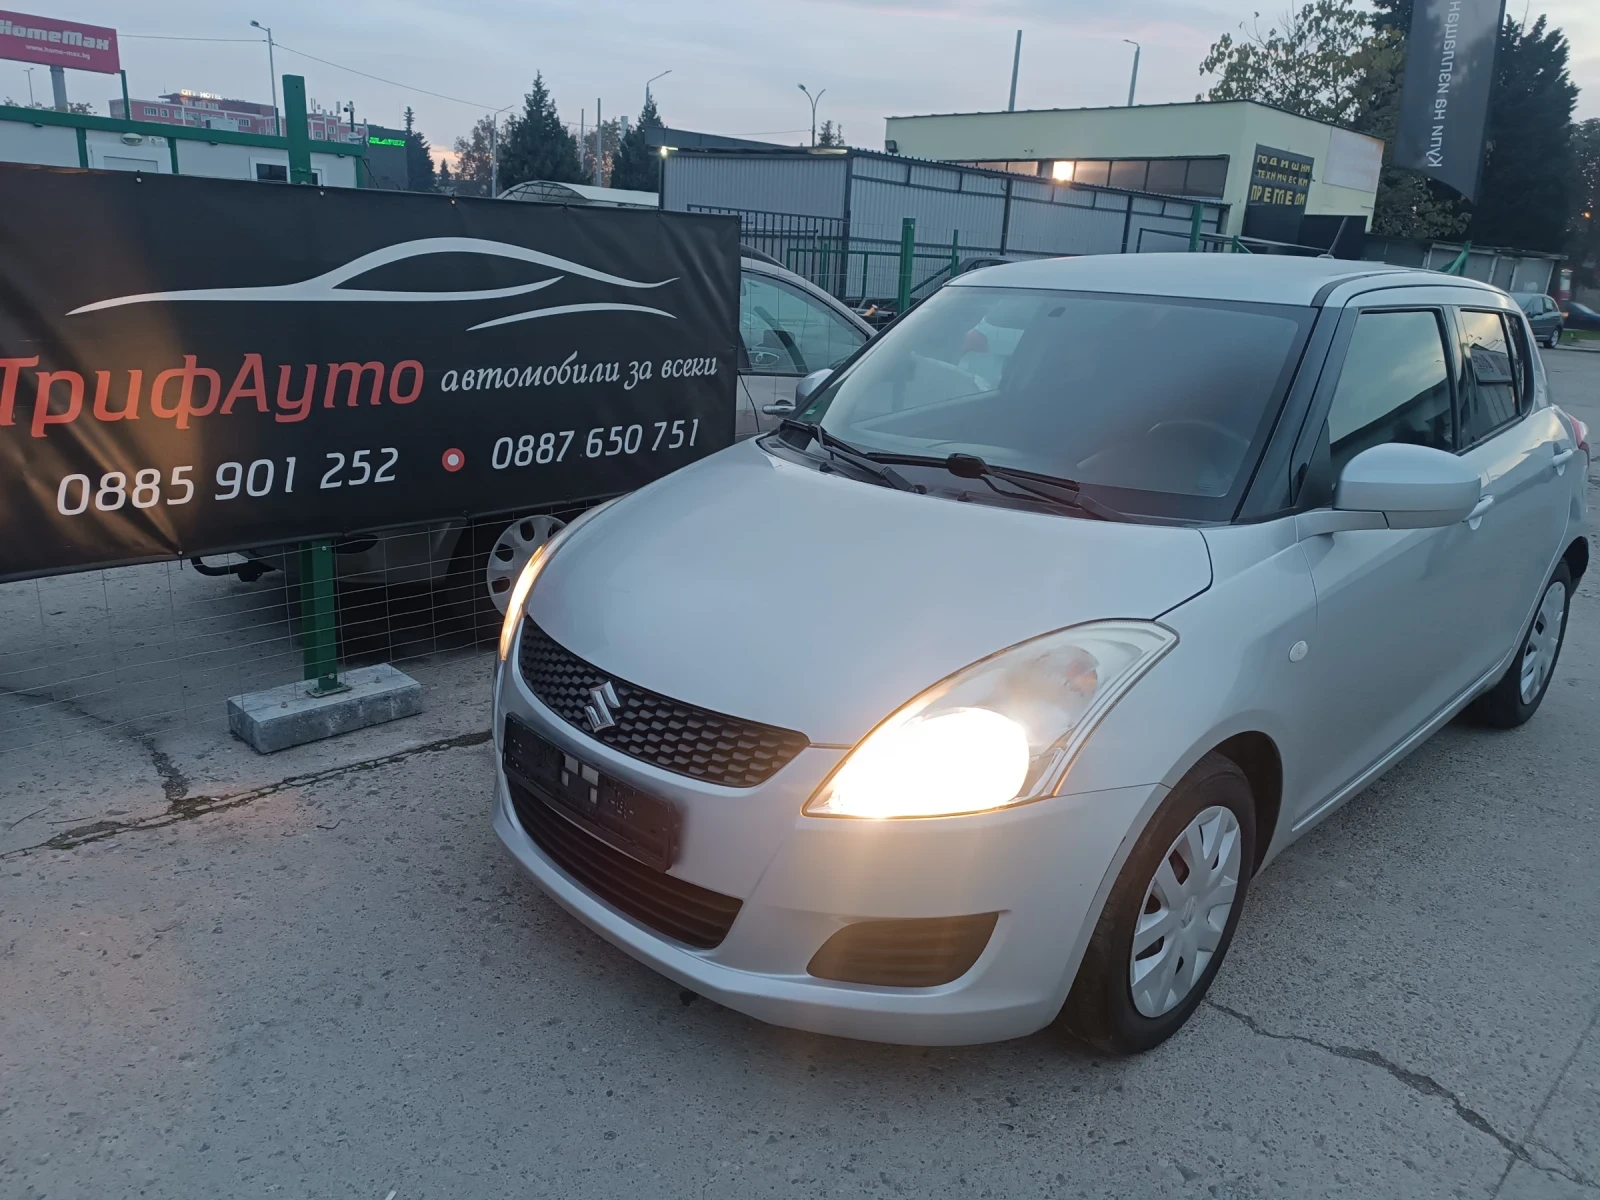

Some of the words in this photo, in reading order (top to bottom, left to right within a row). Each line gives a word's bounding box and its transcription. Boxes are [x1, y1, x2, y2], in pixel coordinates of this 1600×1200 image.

[0, 20, 109, 50] HomeMax
[25, 45, 91, 60] www.home-max.bg
[200, 91, 222, 99] HOTEL
[1257, 154, 1310, 172] ГОДИШНИ
[1258, 169, 1308, 186] ТЕХНИЧЕСКИ
[1250, 185, 1305, 205] ПРЕГЛЕДИ
[440, 351, 620, 391] автомобили
[624, 360, 652, 390] за
[661, 356, 717, 379] всеки
[0, 353, 424, 438] ТрифАуто
[492, 430, 575, 469] 0887
[585, 424, 643, 458] 650
[651, 418, 699, 451] 751
[57, 466, 195, 516] 0885
[215, 457, 296, 500] 901
[320, 447, 399, 489] 252
